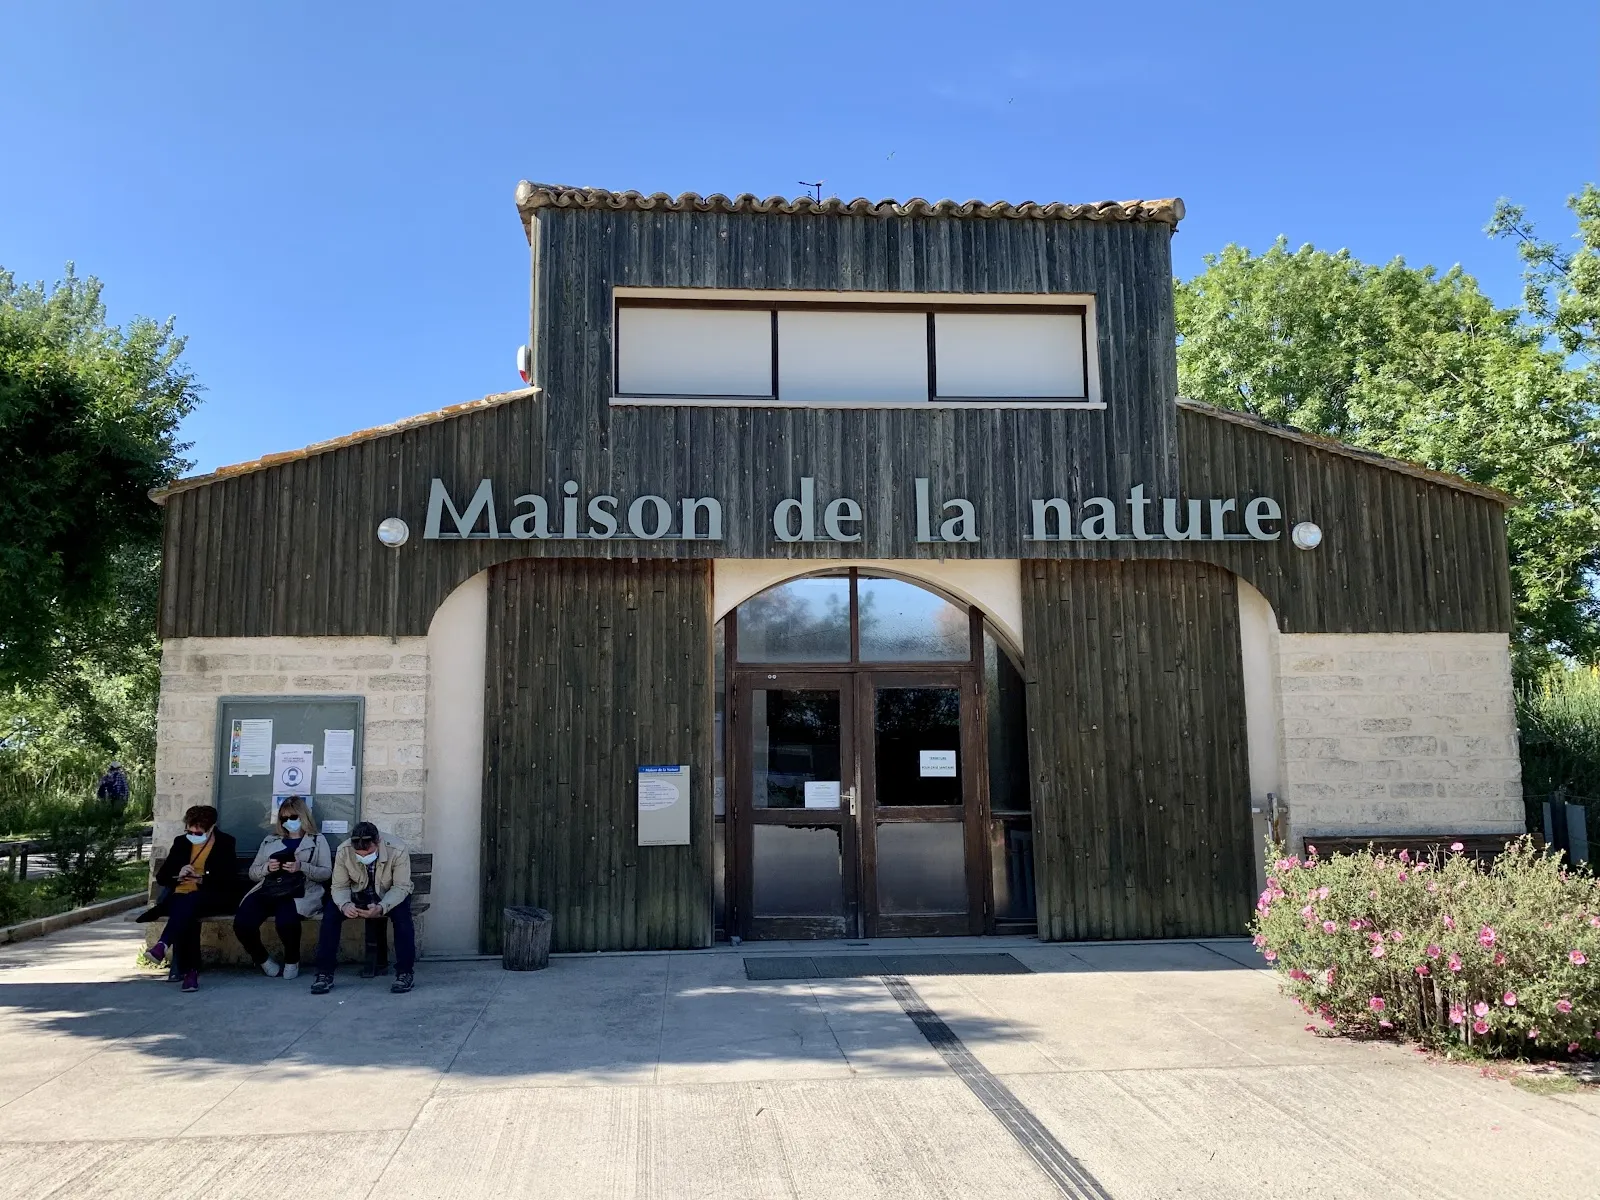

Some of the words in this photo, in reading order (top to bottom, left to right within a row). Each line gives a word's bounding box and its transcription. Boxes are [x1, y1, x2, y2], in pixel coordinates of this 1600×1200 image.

[423, 478, 723, 541] Maison
[774, 477, 862, 542] de
[914, 478, 980, 542] la
[1032, 483, 1282, 541] nature
